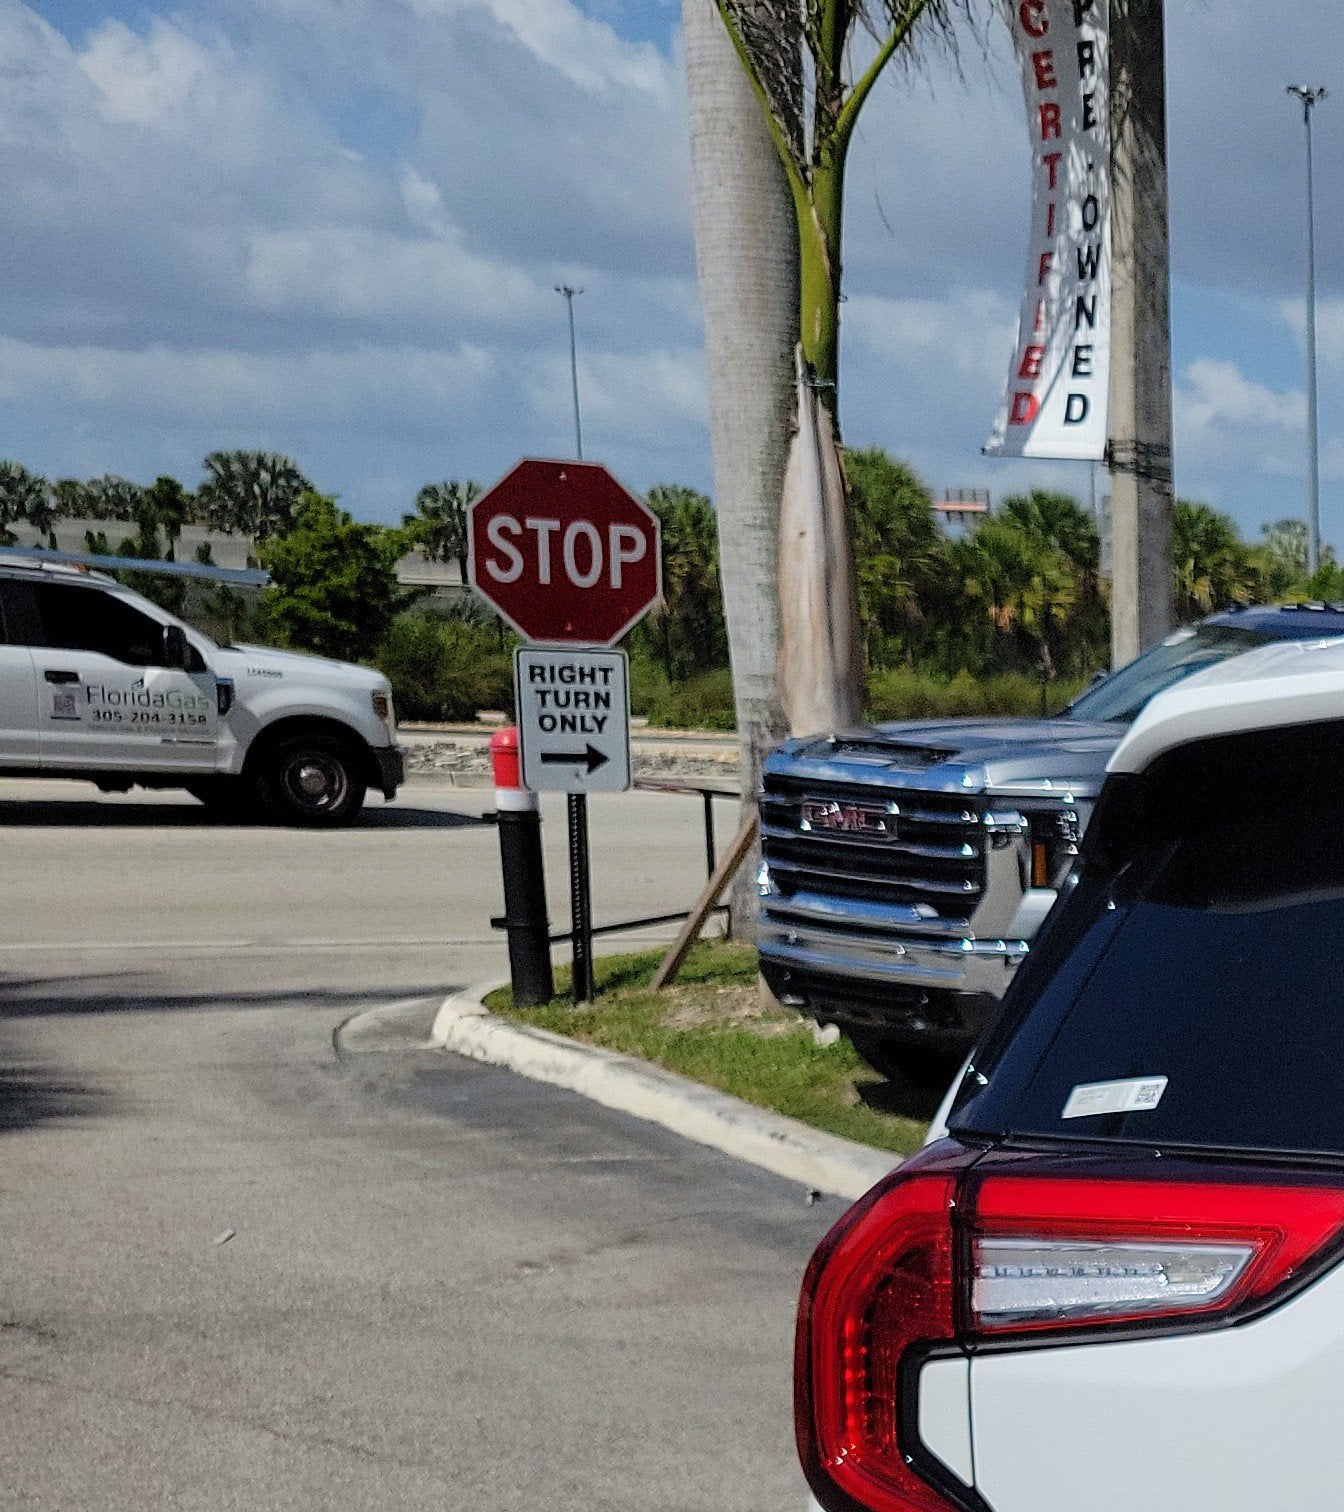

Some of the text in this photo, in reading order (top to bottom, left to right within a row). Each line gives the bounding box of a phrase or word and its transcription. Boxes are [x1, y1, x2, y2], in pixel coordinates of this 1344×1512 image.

[1009, 0, 1062, 426] CERTIFIED
[485, 515, 648, 590] STOP
[528, 664, 614, 687] RIGHT
[535, 689, 612, 710] TURN
[538, 714, 609, 734] ONLY
